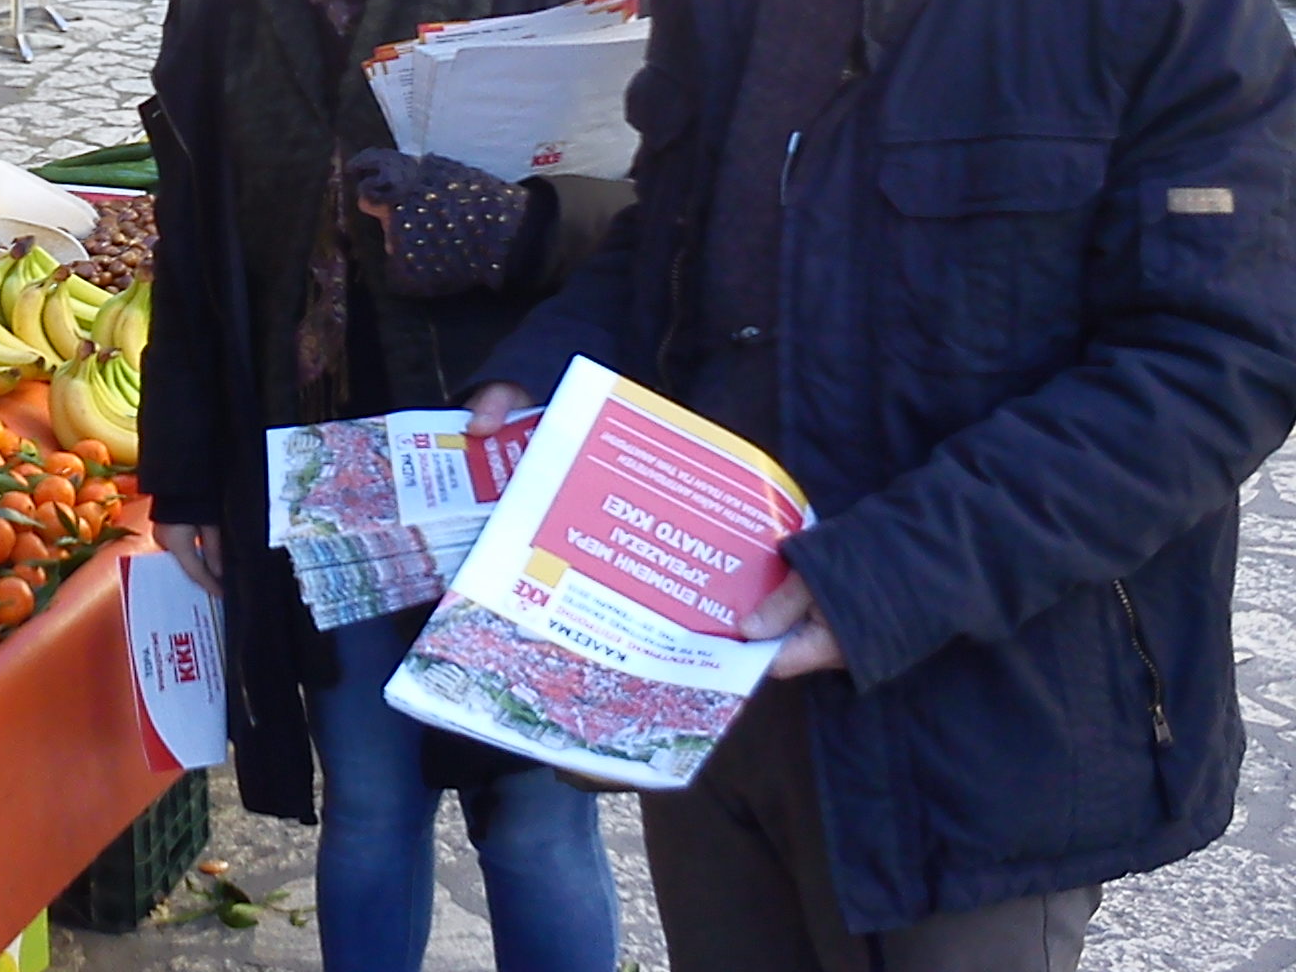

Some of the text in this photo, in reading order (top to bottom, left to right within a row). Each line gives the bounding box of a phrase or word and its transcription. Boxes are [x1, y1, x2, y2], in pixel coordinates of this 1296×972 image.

[610, 527, 711, 587] ΧΡΕΙΑΖΕΣΑΙ
[655, 522, 742, 574] ΔΥΝΑΤΟ
[512, 578, 550, 607] ΚΚΕ
[567, 527, 735, 626] ΤΗΝ ΕΠΟΜΕΝΗ ΜΕΡΑ
[173, 632, 196, 682] ΚΚΕ
[549, 618, 626, 661] ΚΑΛΕΣΜΑ
